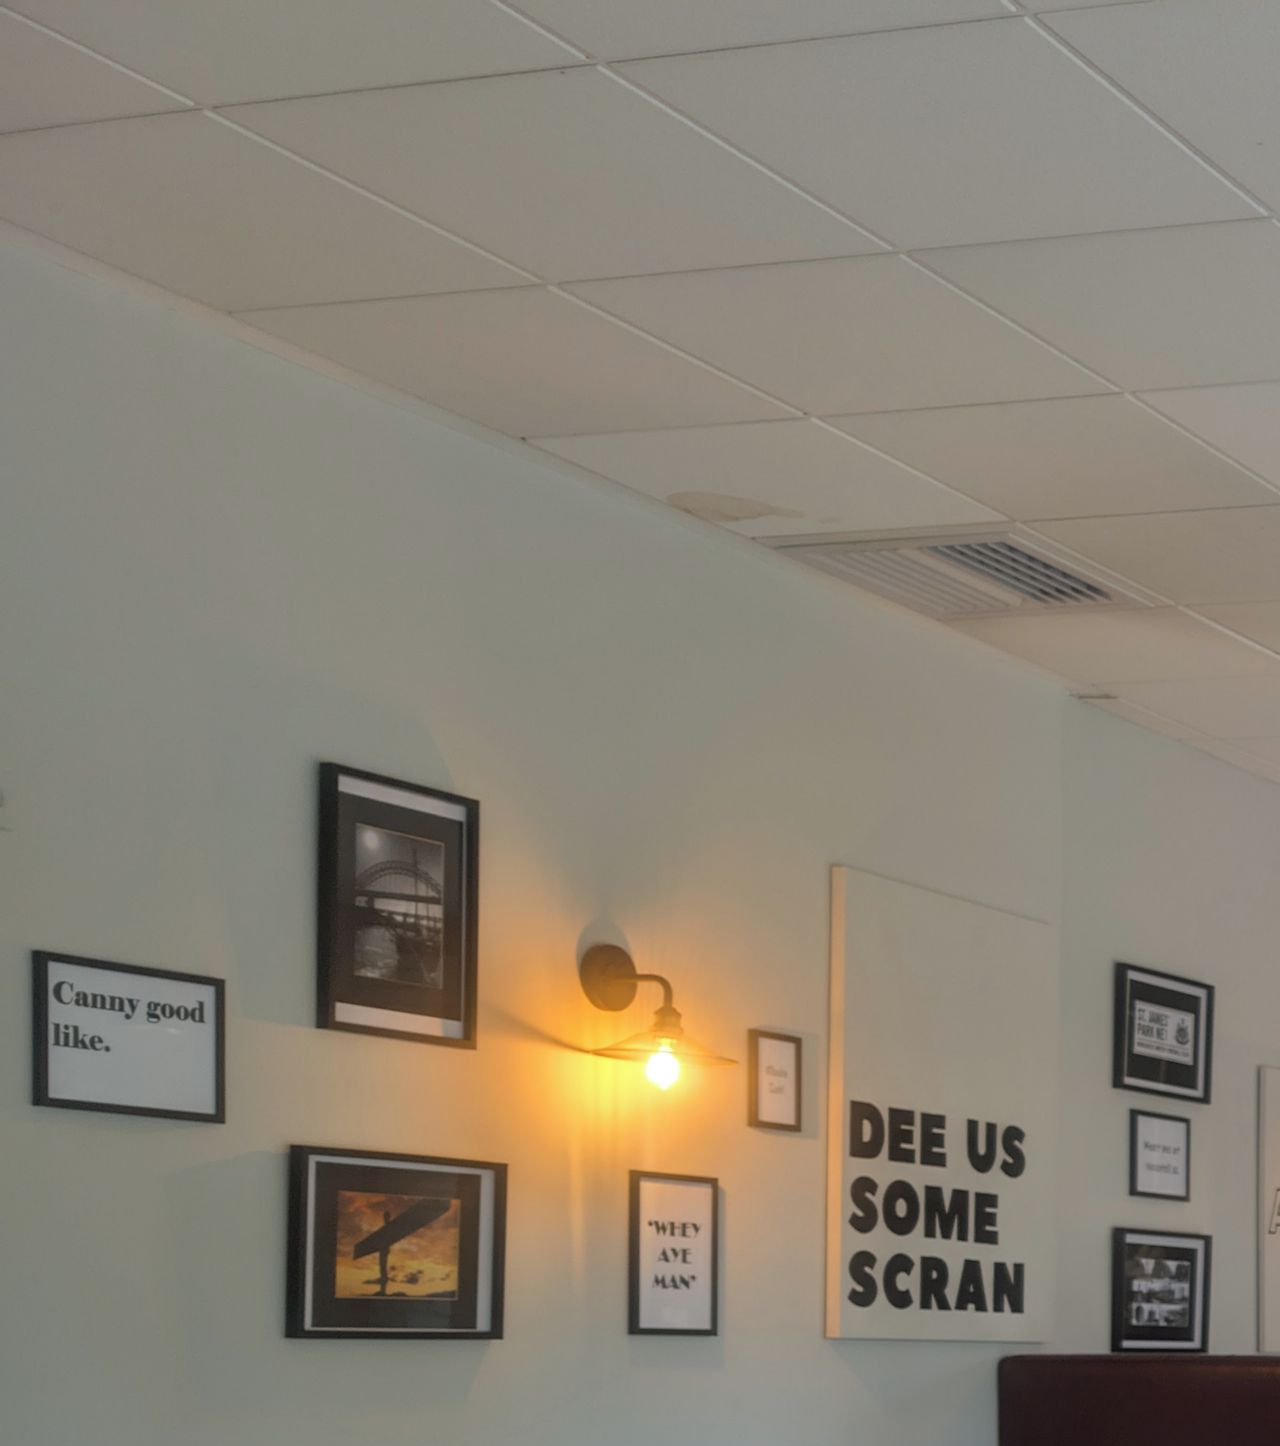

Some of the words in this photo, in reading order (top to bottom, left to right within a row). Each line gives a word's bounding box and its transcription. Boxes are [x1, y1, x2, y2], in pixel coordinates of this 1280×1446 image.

[52, 980, 140, 1020] Canny
[146, 1000, 206, 1024] good
[52, 1022, 111, 1053] like.
[849, 1099, 947, 1168] DEE
[967, 1118, 1026, 1179] US
[848, 1175, 999, 1246] SOME
[657, 1247, 694, 1265] AYE
[847, 1250, 1024, 1314] SCRAN
